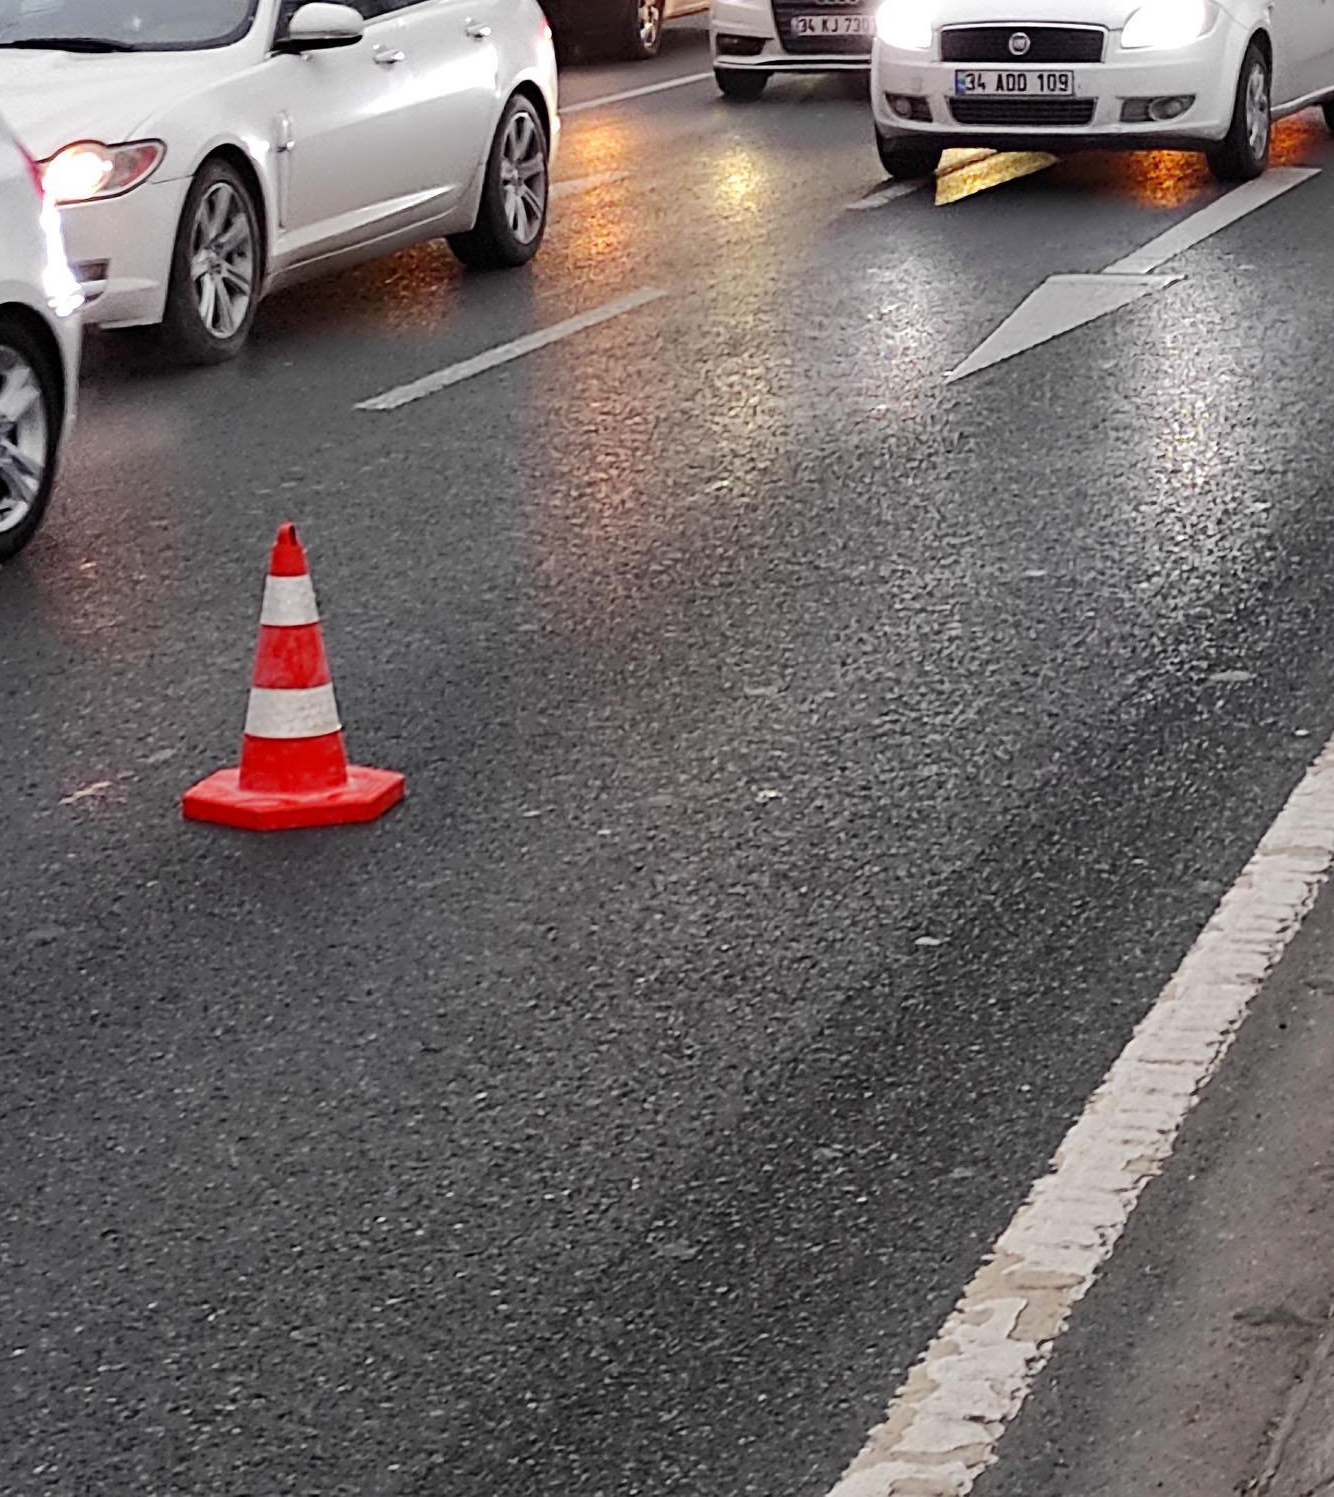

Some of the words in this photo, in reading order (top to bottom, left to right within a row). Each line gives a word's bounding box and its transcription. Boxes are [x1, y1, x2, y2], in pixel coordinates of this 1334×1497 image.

[798, 18, 815, 33] 34
[965, 73, 986, 91] 34
[1037, 73, 1069, 92] 109
